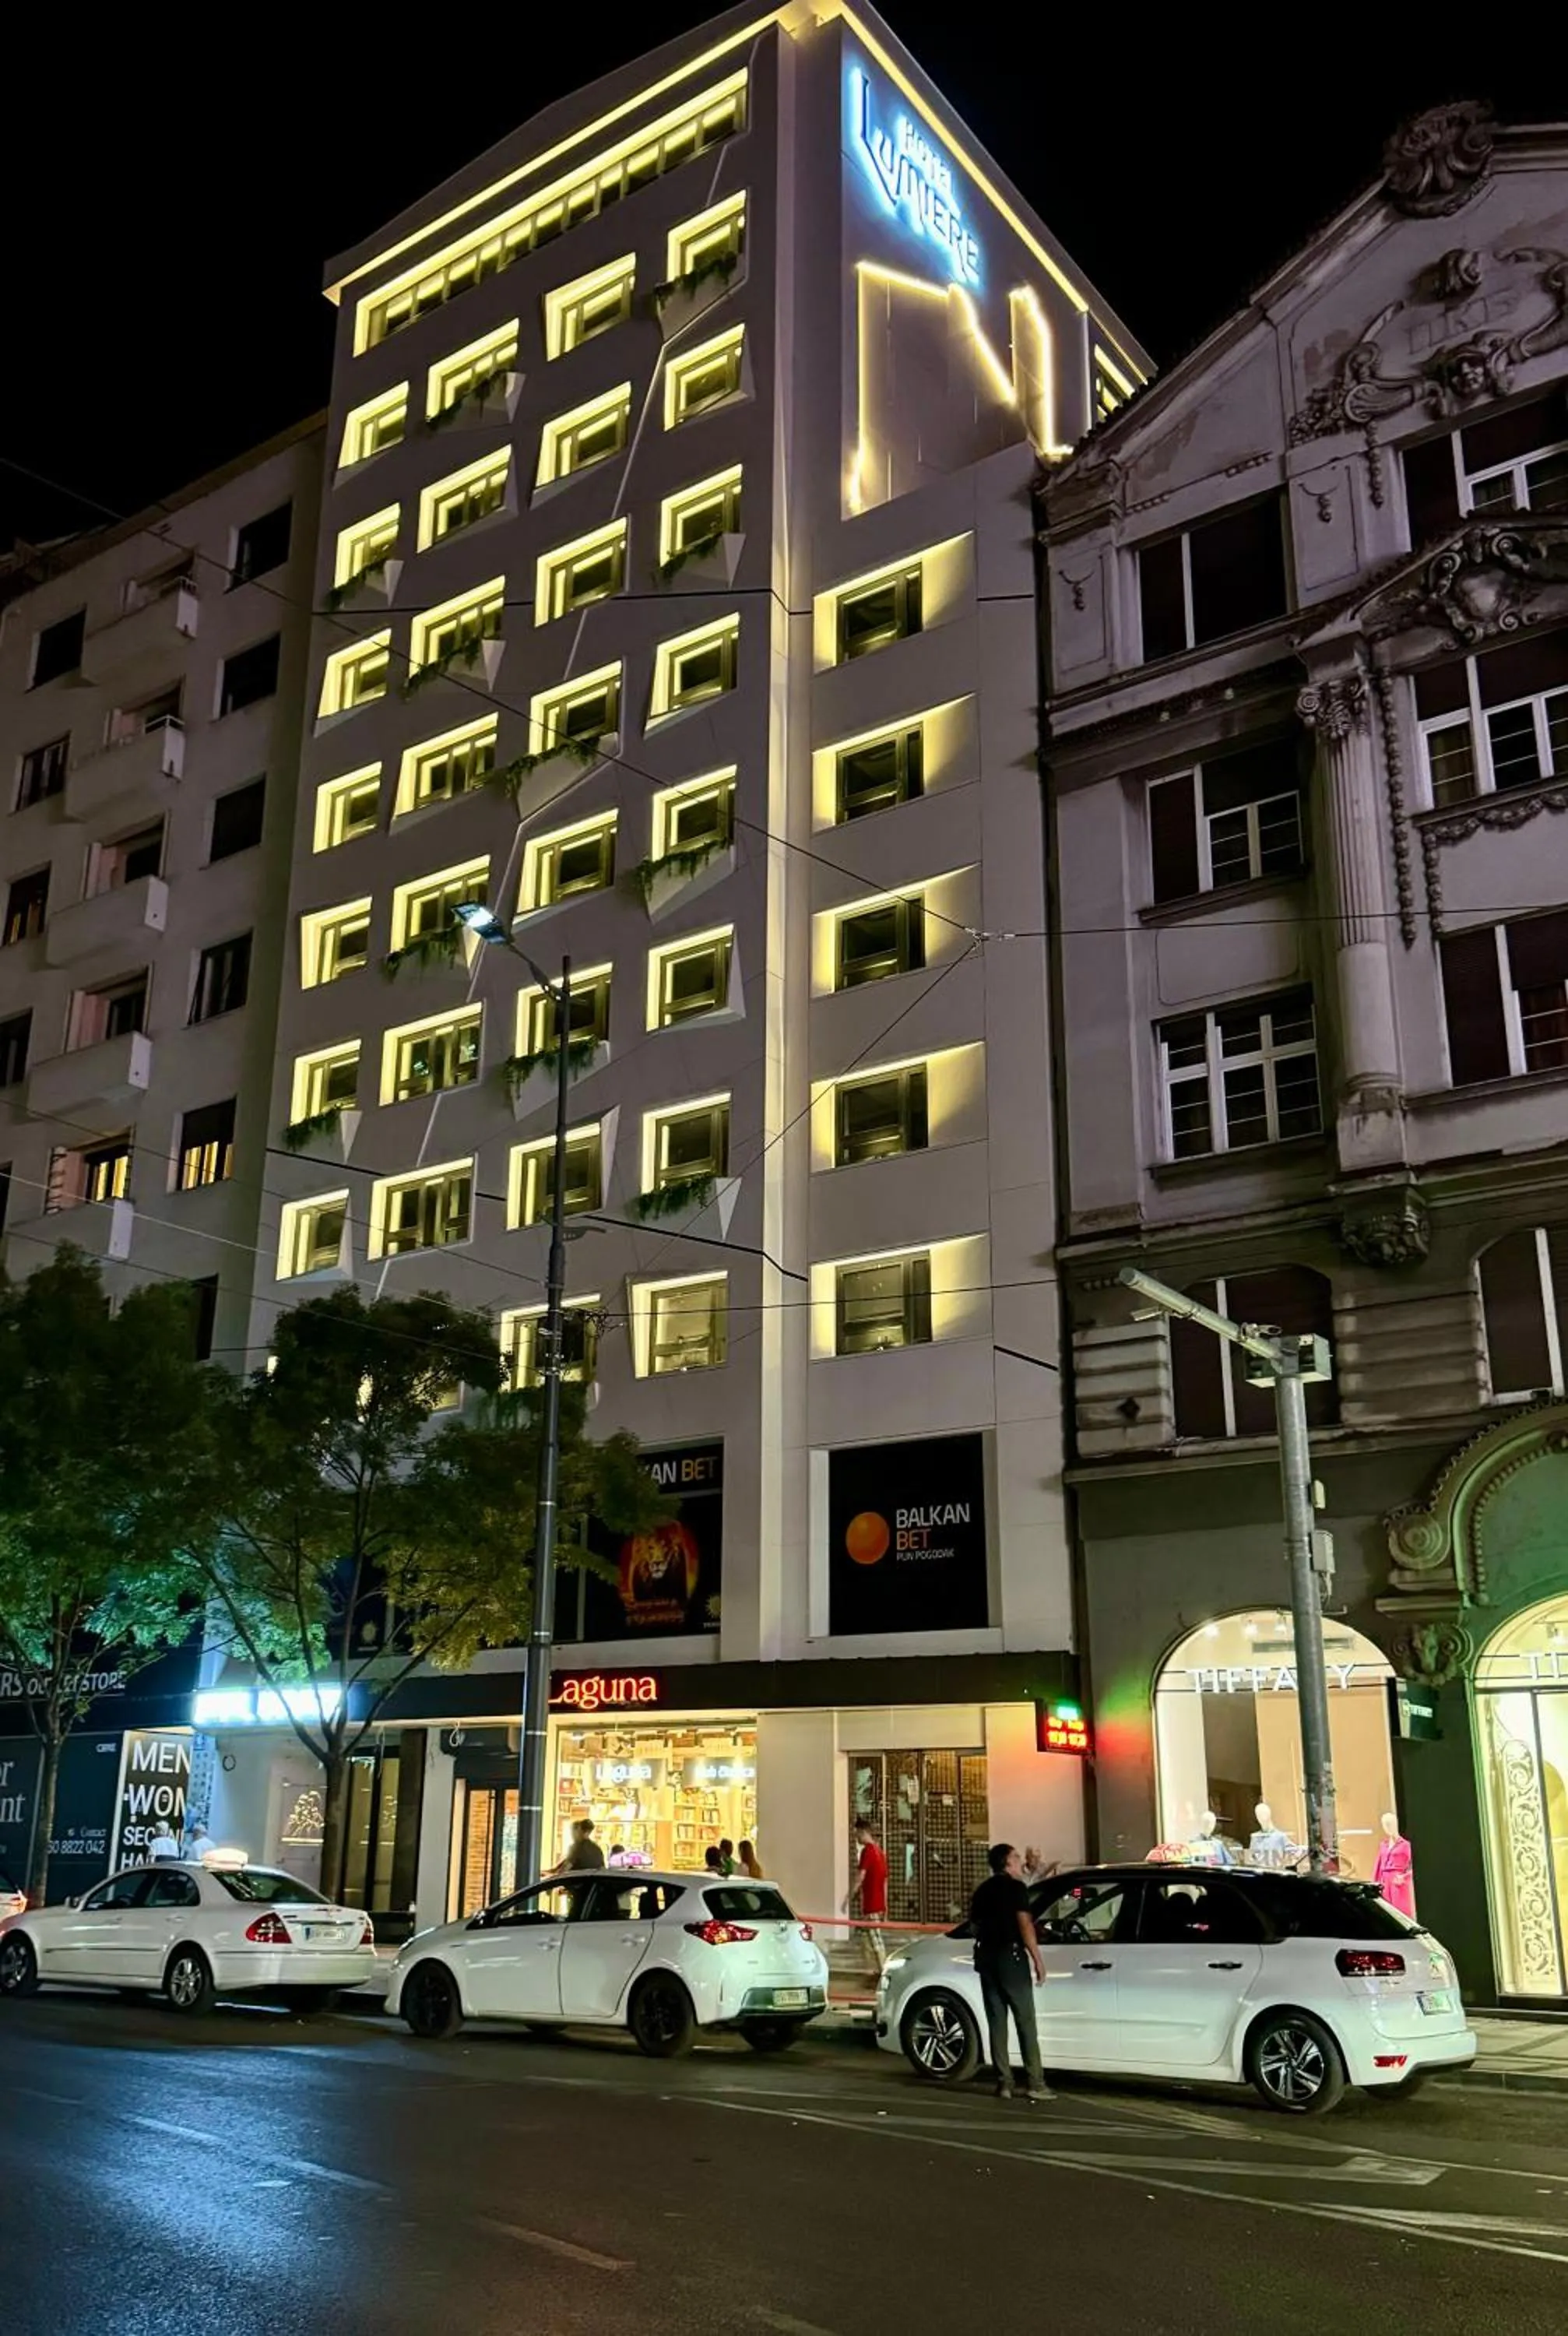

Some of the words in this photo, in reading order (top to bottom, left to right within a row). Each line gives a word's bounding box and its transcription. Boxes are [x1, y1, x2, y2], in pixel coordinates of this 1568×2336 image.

[681, 1456, 719, 1481] BET
[896, 1502, 971, 1529] BALKAN
[896, 1529, 932, 1551] BET
[1186, 1662, 1357, 1694] TIFFAY
